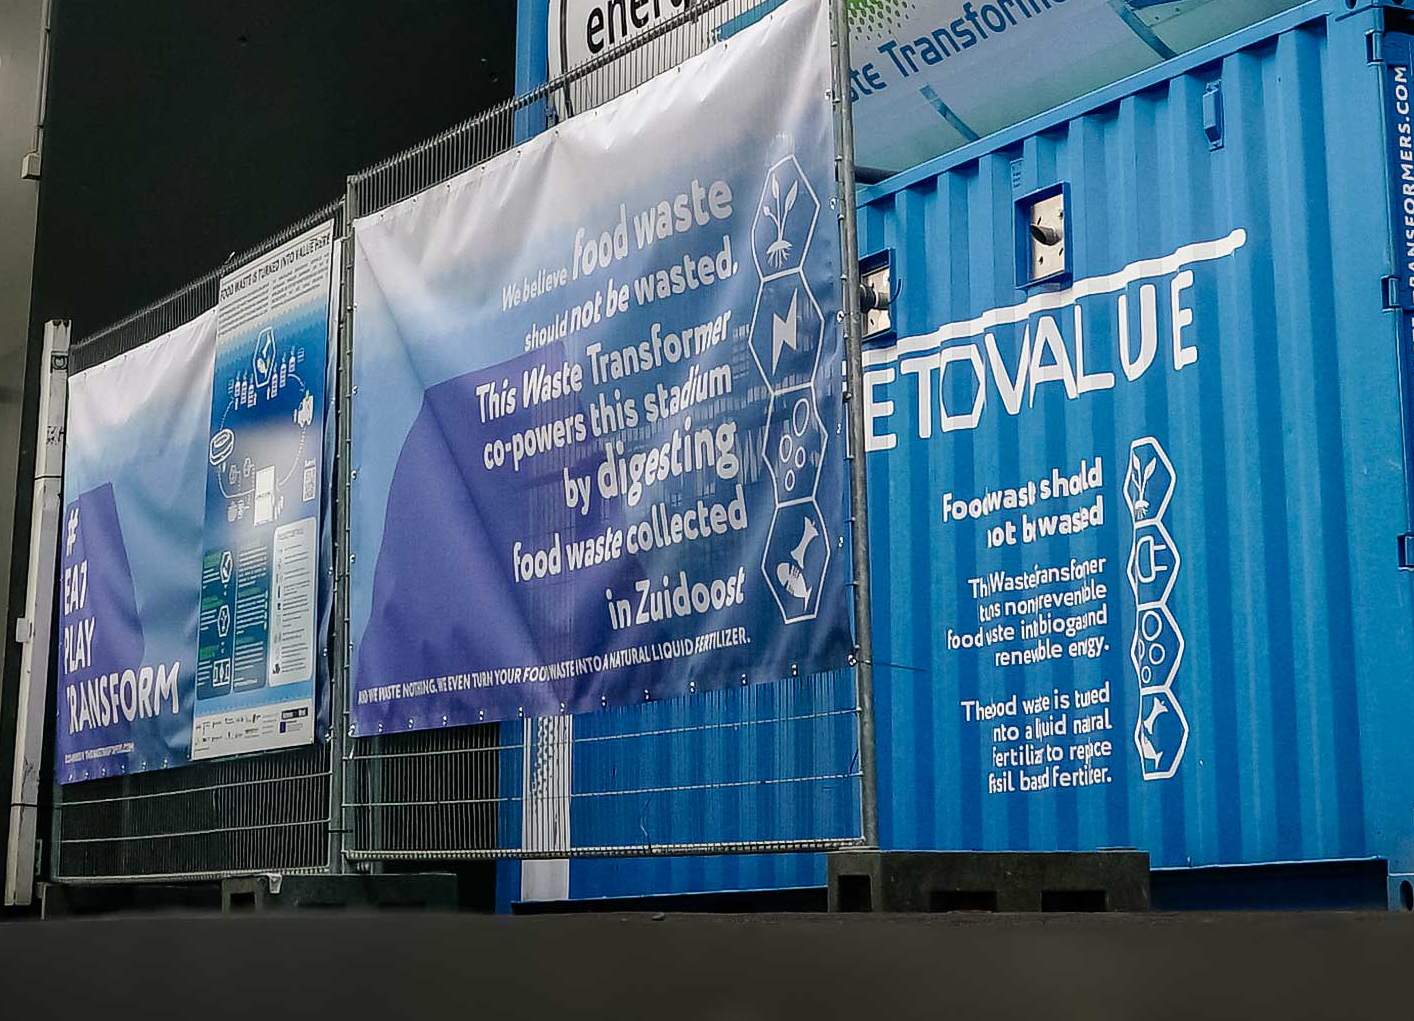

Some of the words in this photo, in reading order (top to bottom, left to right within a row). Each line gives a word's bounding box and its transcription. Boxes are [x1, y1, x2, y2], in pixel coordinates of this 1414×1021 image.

[501, 285, 521, 311] We
[522, 267, 569, 303] believe
[572, 203, 628, 280] food
[633, 179, 733, 250] waste
[524, 310, 568, 352] should
[570, 291, 603, 333] not
[605, 279, 630, 318] be
[634, 235, 739, 305] wasted.
[476, 378, 516, 423] This
[522, 362, 583, 408] Waste
[586, 310, 732, 385] Transformer
[483, 412, 587, 471] co-powers
[589, 388, 638, 437] this
[643, 363, 732, 422] stadium
[563, 466, 591, 515] by
[597, 416, 739, 507] digesting
[513, 532, 561, 583] food
[565, 527, 623, 571] waste
[626, 483, 748, 555] collected
[605, 588, 631, 630] in
[635, 566, 746, 626] Zuidoost
[64, 617, 95, 674] PLAY
[448, 673, 471, 691] EVEN
[472, 670, 493, 688] TURN
[494, 667, 521, 686] YOUR
[548, 660, 575, 680] WASTE
[575, 654, 602, 675] INTO
[602, 653, 609, 670] A
[609, 644, 651, 669] NATURAL
[651, 638, 694, 663] LIQUID
[694, 626, 751, 654] FERTILIZER.
[947, 628, 984, 650] food
[1053, 688, 1070, 709] is
[1025, 725, 1033, 740] a
[1046, 744, 1064, 762] to
